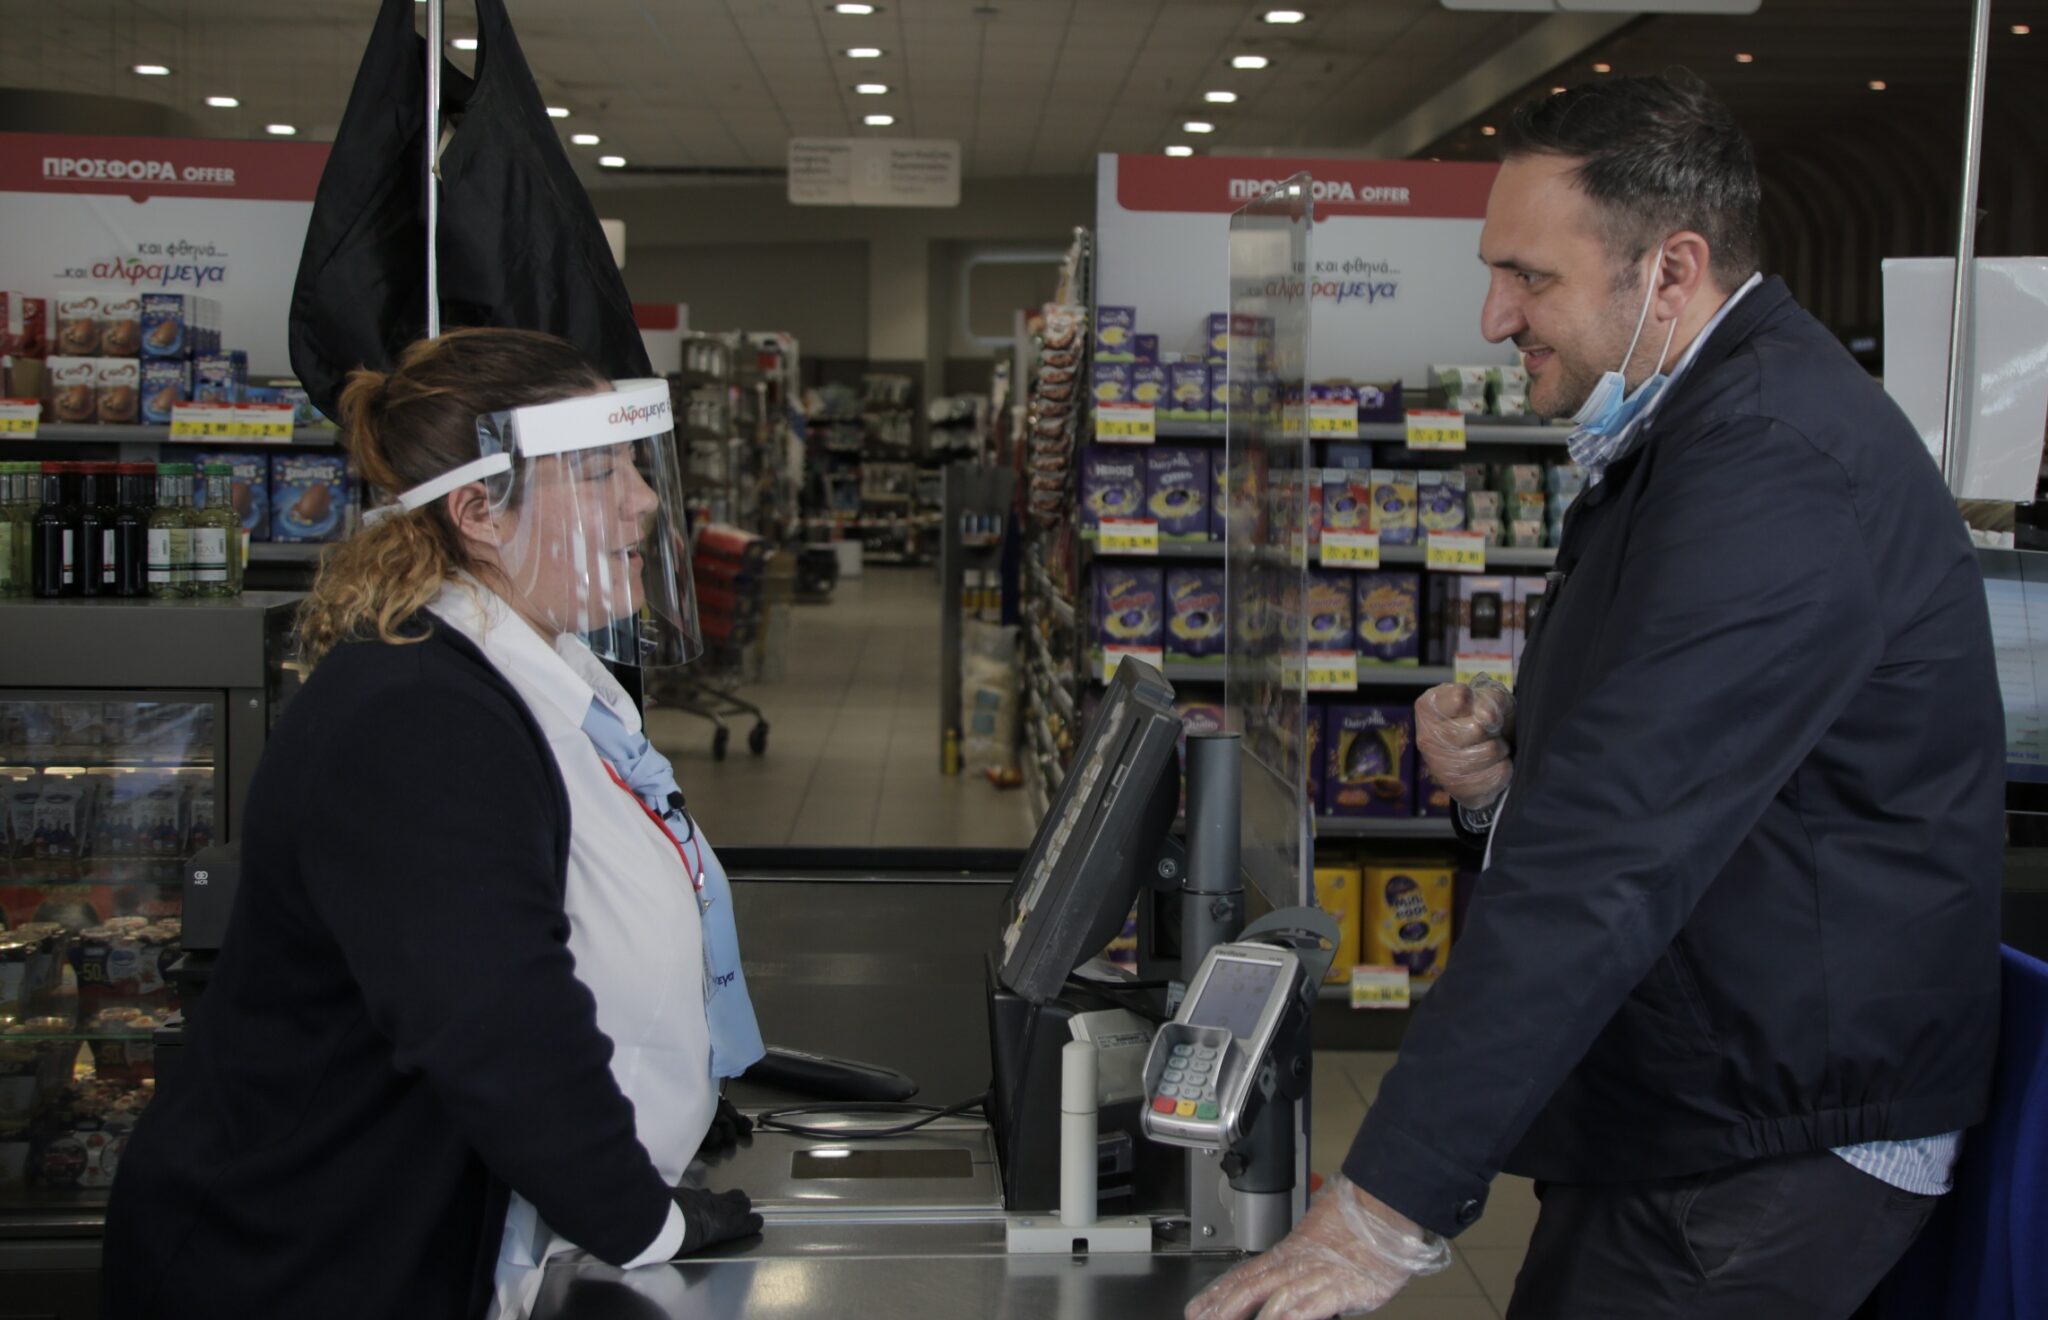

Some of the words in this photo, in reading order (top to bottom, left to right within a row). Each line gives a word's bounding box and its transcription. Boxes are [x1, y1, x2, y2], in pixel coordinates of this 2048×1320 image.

[43, 157, 177, 180] ΠΡΟΣΦΟΡΑ
[183, 166, 235, 182] OFFER
[1361, 186, 1410, 202] OFFER
[138, 242, 162, 256] και
[92, 256, 226, 287] αλφαμεγα
[1315, 261, 1338, 273] και
[1096, 464, 1135, 477] HEROES
[1345, 716, 1367, 729] Dairy
